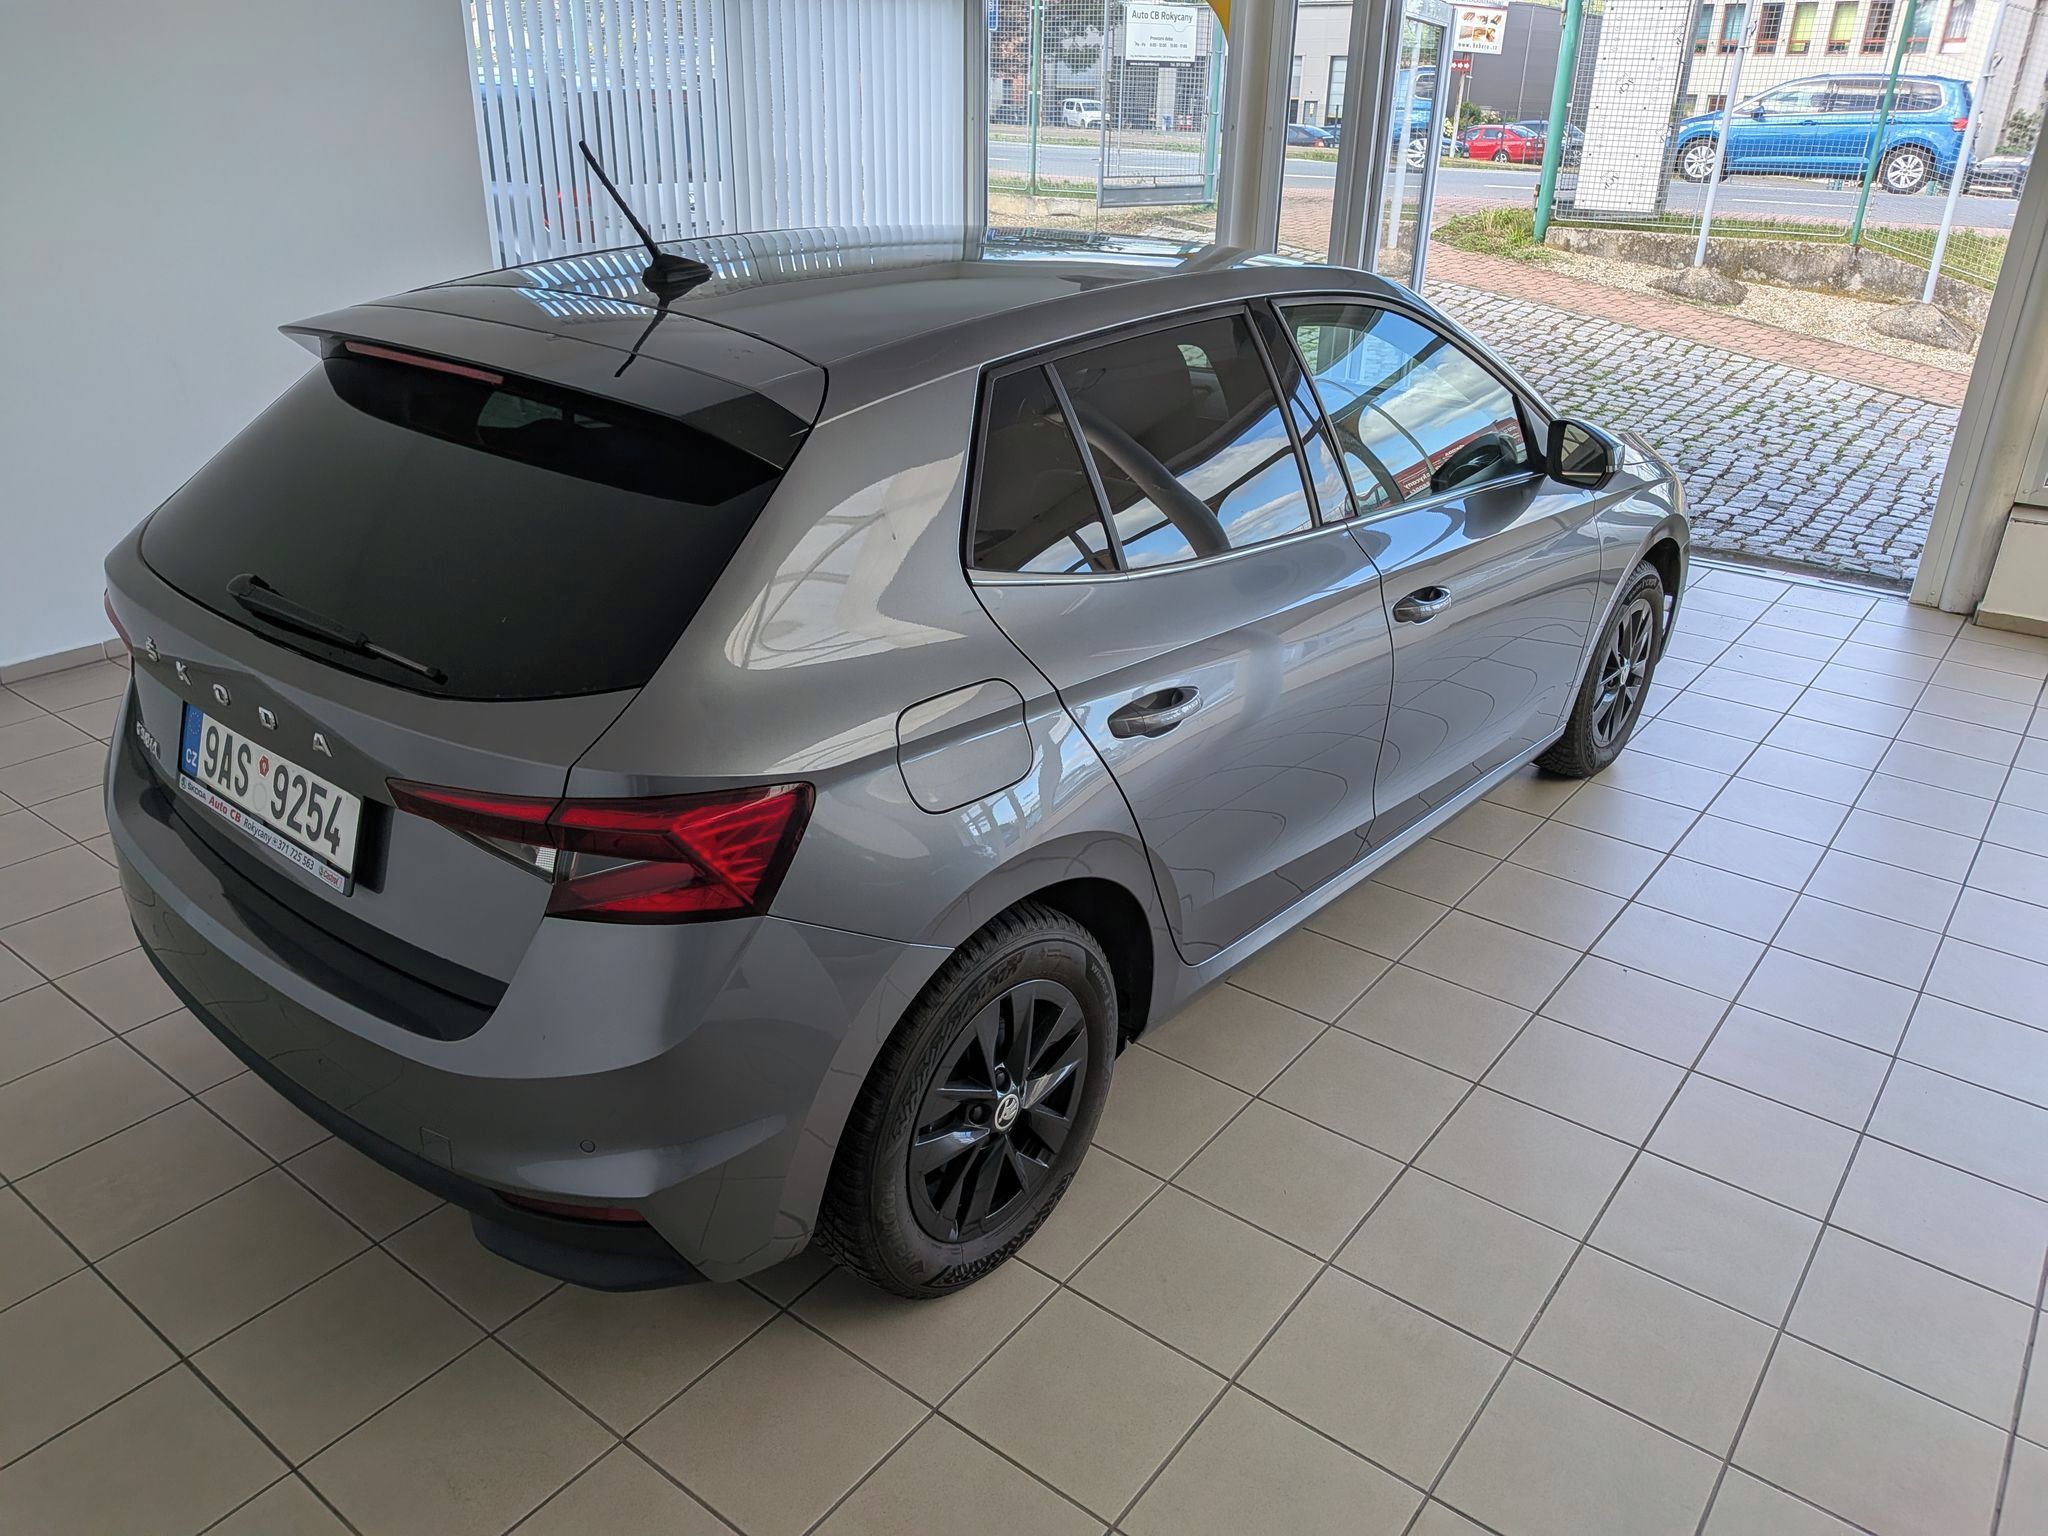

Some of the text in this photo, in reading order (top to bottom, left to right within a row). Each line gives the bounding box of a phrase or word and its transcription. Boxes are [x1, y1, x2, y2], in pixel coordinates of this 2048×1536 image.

[1132, 10, 1193, 24] Auto CB Rokycany
[146, 634, 334, 758] ŠKODA
[186, 748, 197, 767] CZ
[204, 725, 343, 856] 9AS 9254
[208, 796, 228, 815] Auto
[230, 809, 242, 823] CB
[243, 818, 272, 844] Rokycany
[277, 839, 289, 855] 371
[290, 847, 302, 862] 725
[302, 855, 315, 870] 563
